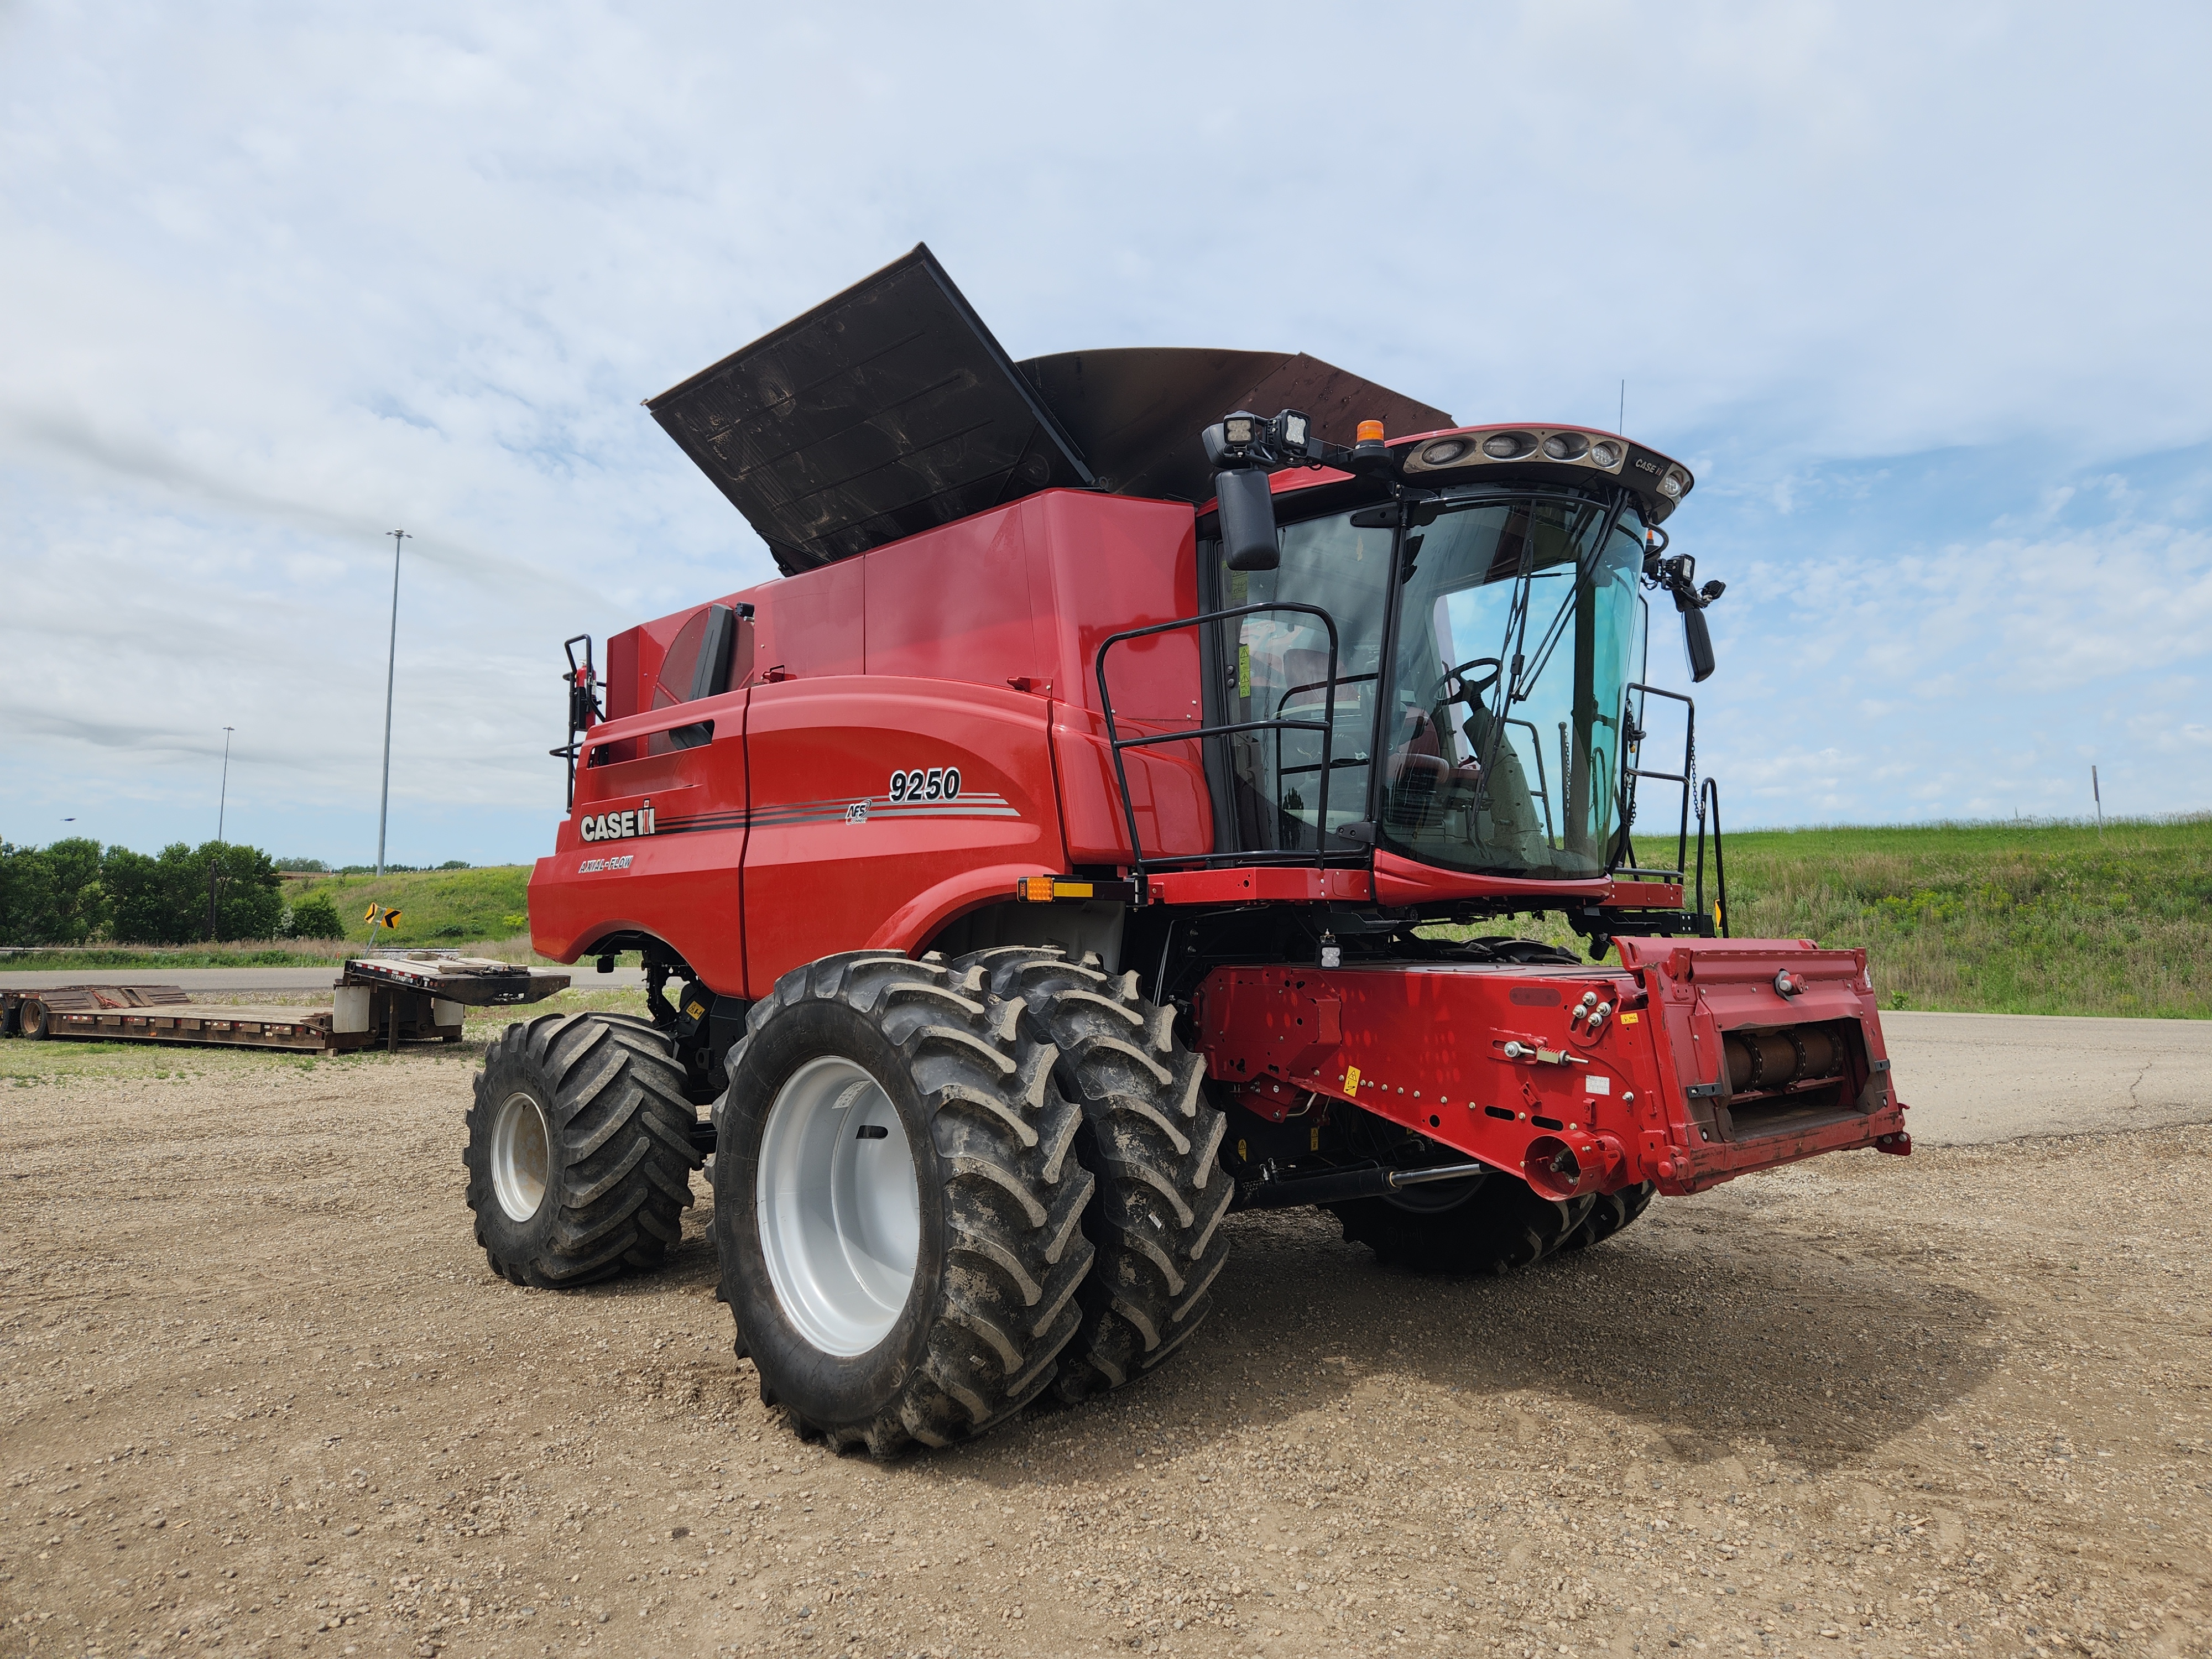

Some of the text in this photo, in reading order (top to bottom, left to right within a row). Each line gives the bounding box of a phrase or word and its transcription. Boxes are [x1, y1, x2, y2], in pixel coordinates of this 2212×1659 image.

[1635, 458, 1657, 473] CASE
[889, 766, 961, 803] 9250
[846, 803, 867, 819] AFS
[581, 810, 635, 842] CASE
[578, 855, 634, 873] AXIAL-FLOW
